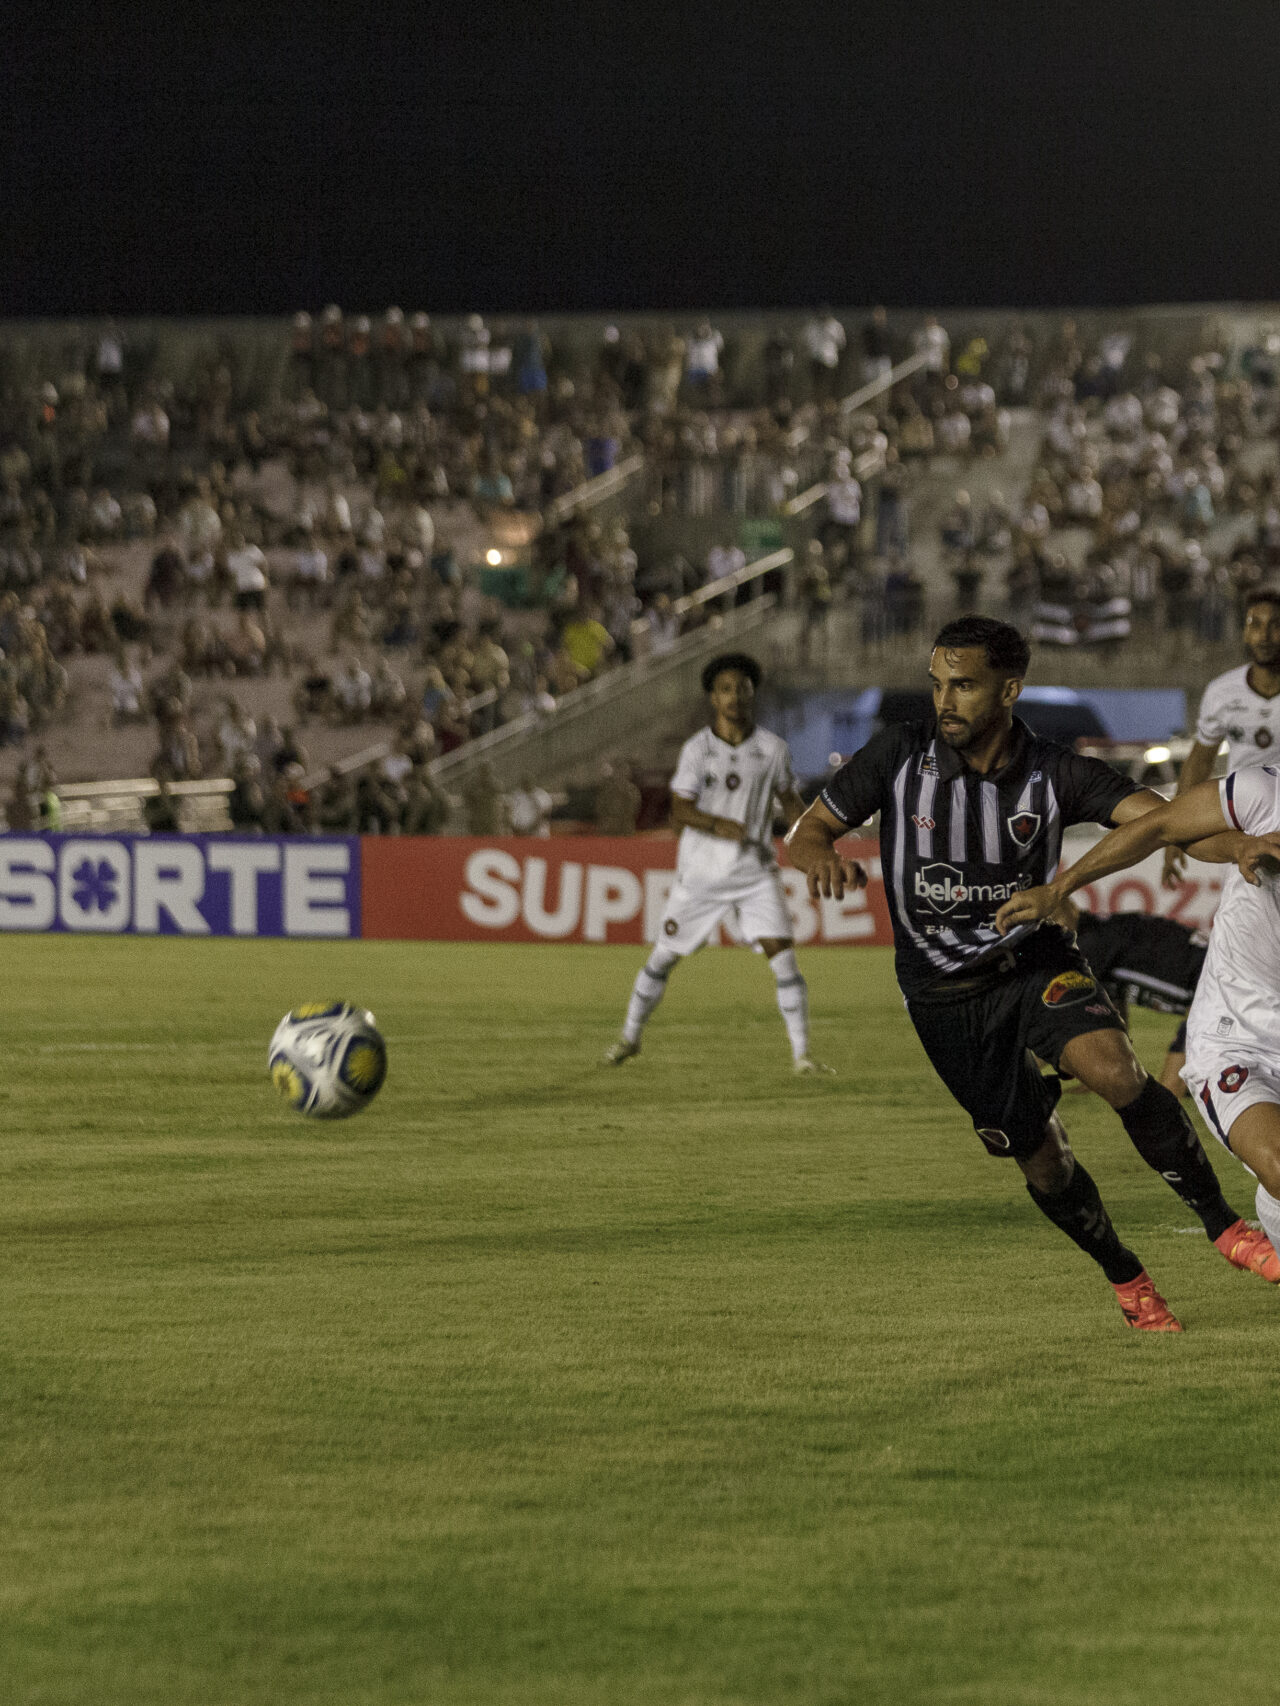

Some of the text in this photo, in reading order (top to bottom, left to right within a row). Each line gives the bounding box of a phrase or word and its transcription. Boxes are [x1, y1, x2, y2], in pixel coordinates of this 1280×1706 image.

[0, 839, 350, 935] SORTE
[460, 848, 883, 946] SUPBE
[914, 871, 1033, 902] belomania
